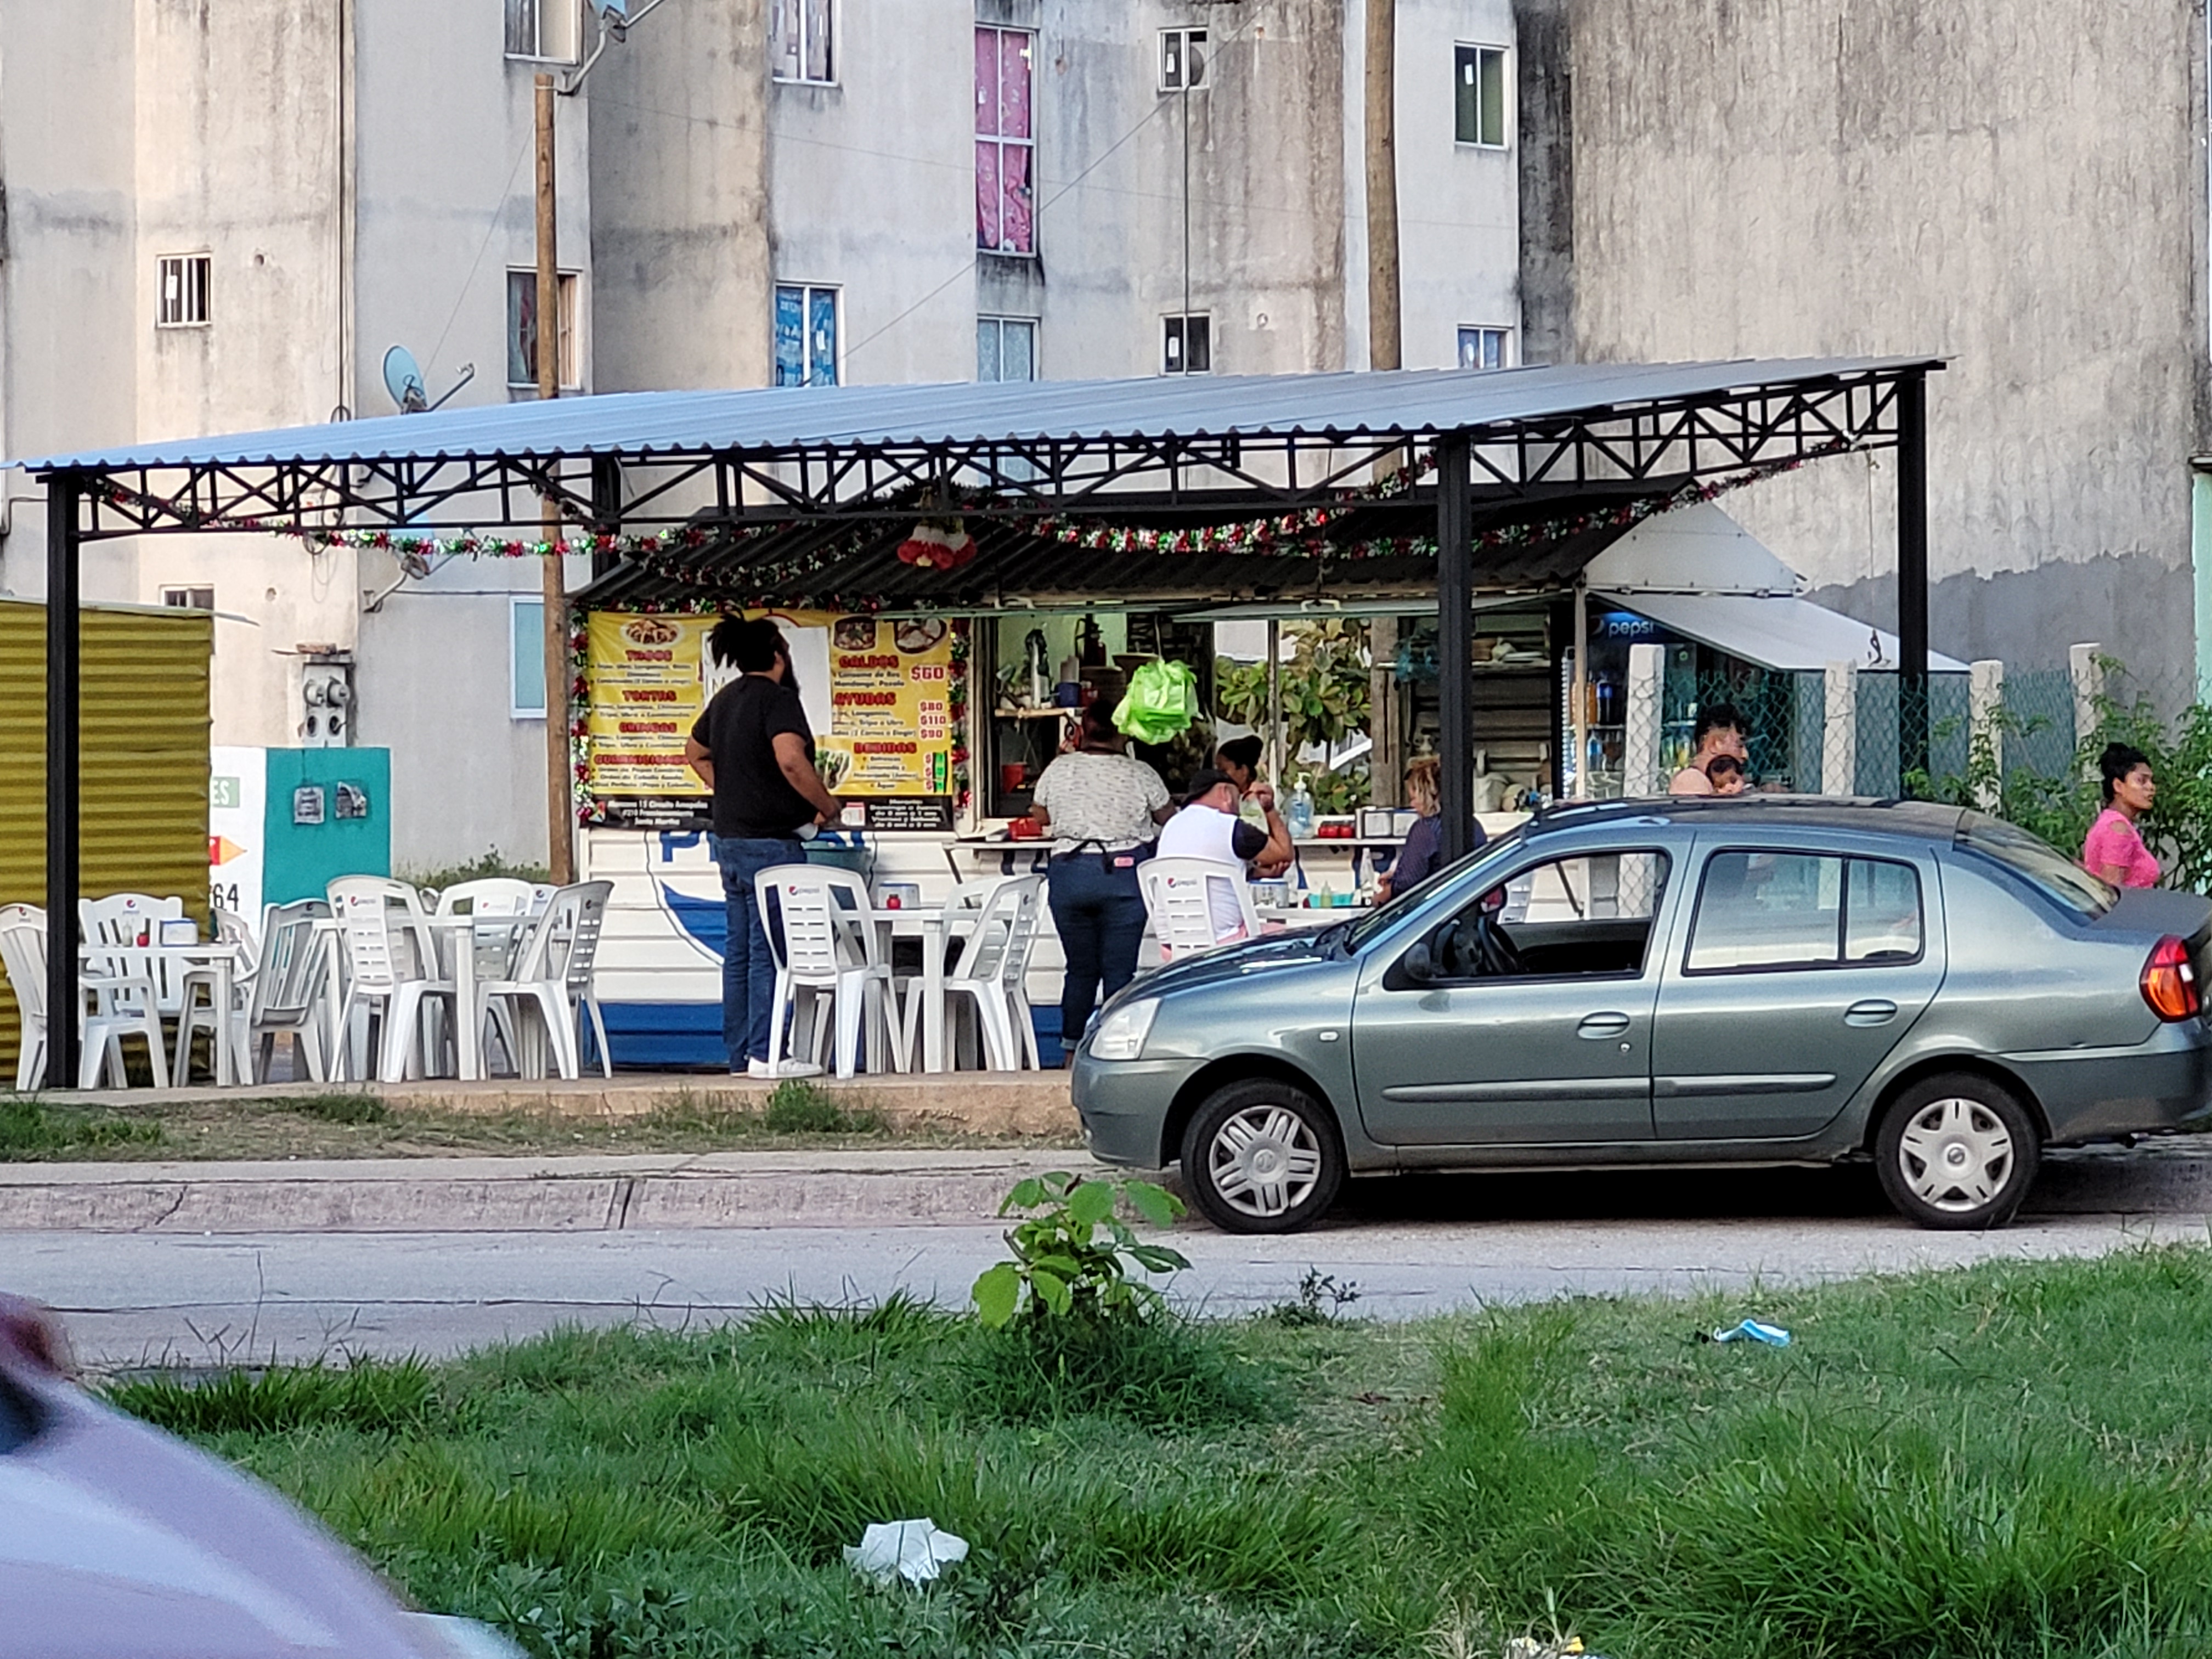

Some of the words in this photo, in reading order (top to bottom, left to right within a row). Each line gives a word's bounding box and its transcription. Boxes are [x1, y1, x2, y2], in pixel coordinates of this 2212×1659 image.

[1609, 620, 1654, 637] pepsi
[839, 655, 899, 668] CALDOS
[911, 665, 944, 681] $60
[920, 715, 946, 725] $110
[212, 883, 239, 912] 64
